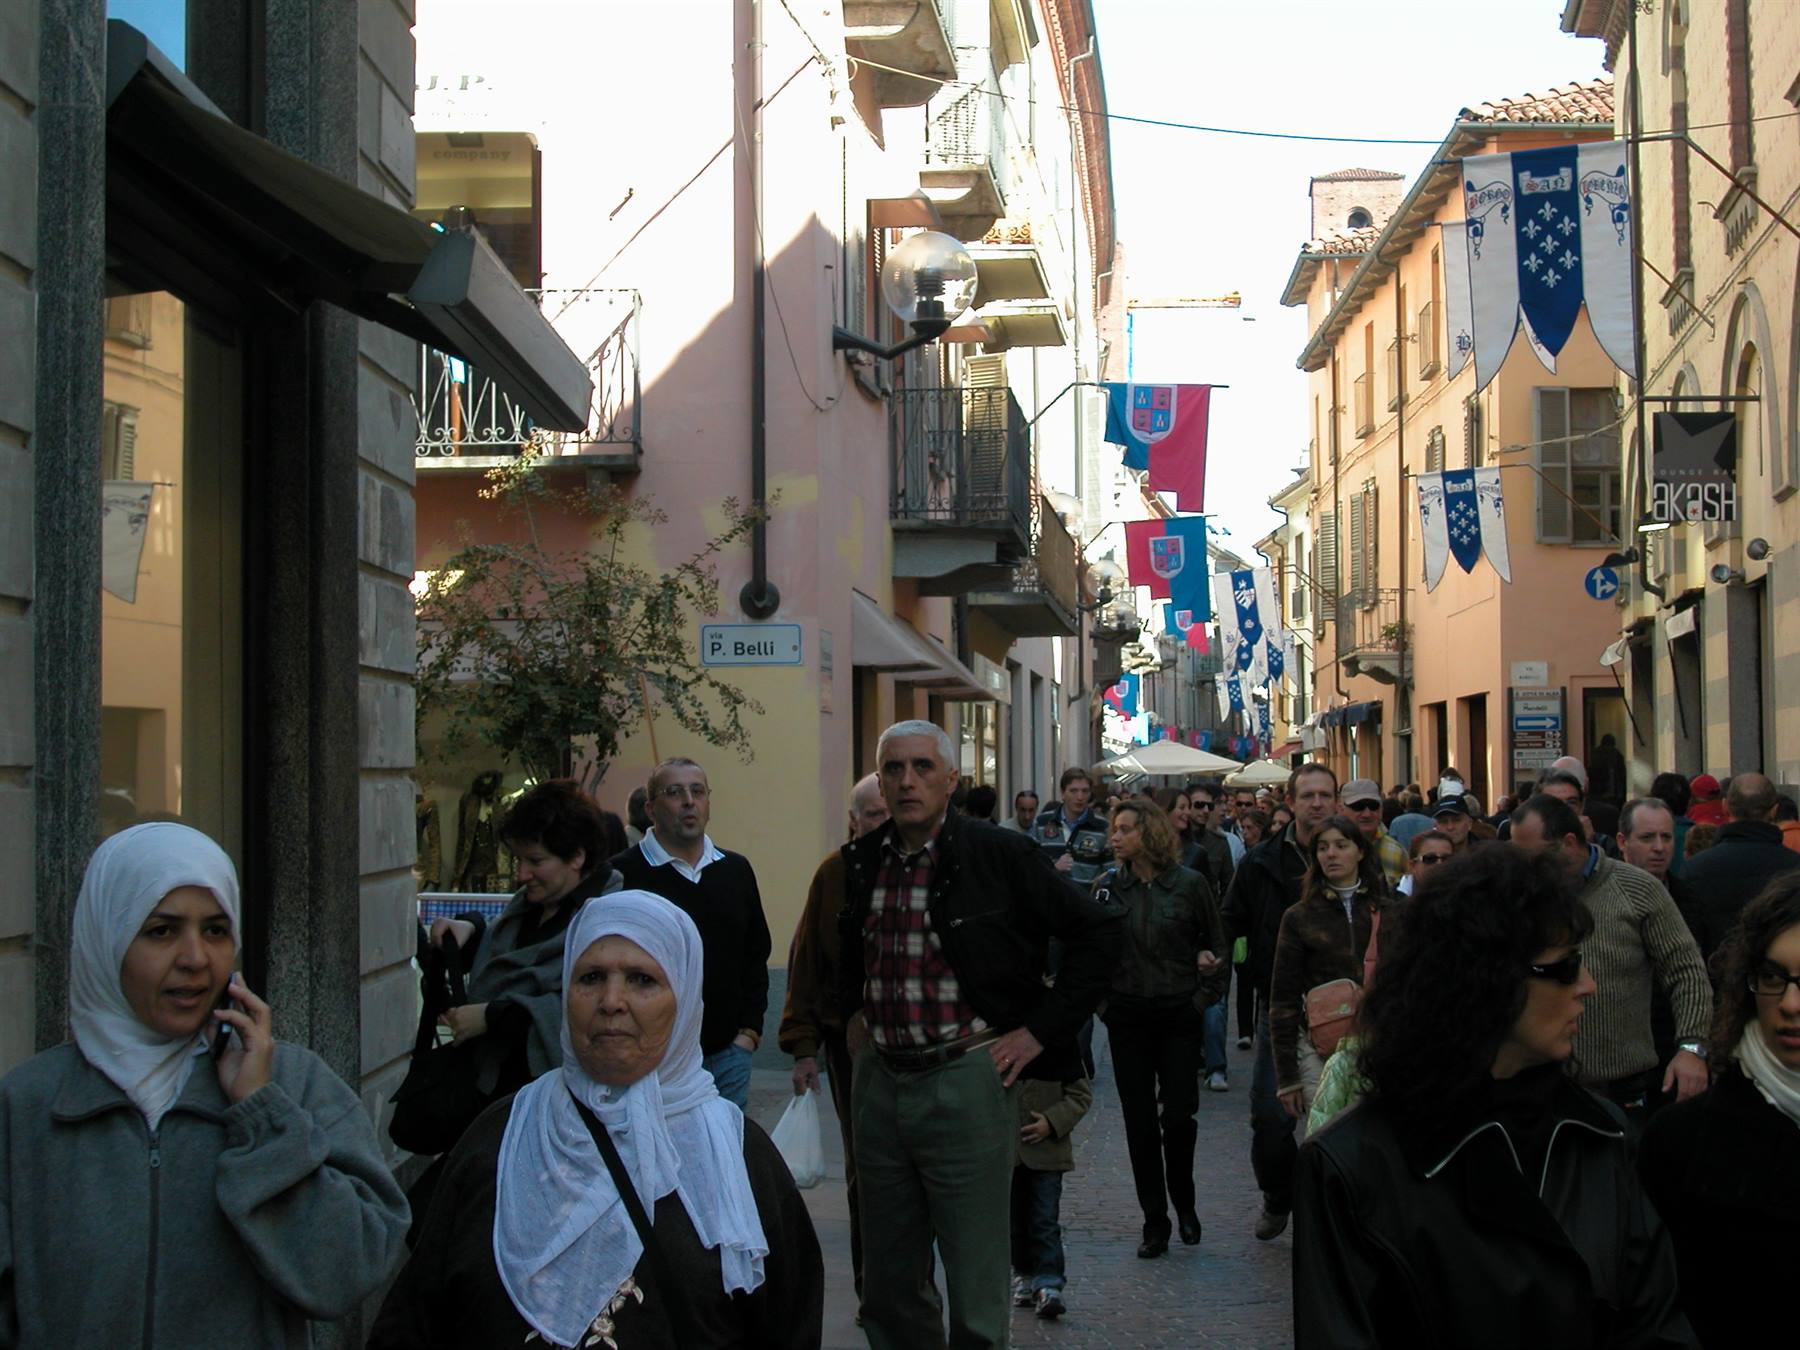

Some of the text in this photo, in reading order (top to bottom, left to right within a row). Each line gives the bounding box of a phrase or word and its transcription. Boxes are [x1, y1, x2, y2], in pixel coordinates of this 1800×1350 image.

[433, 150, 511, 163] company
[710, 632, 723, 640] via
[711, 641, 775, 656] P. Belli
